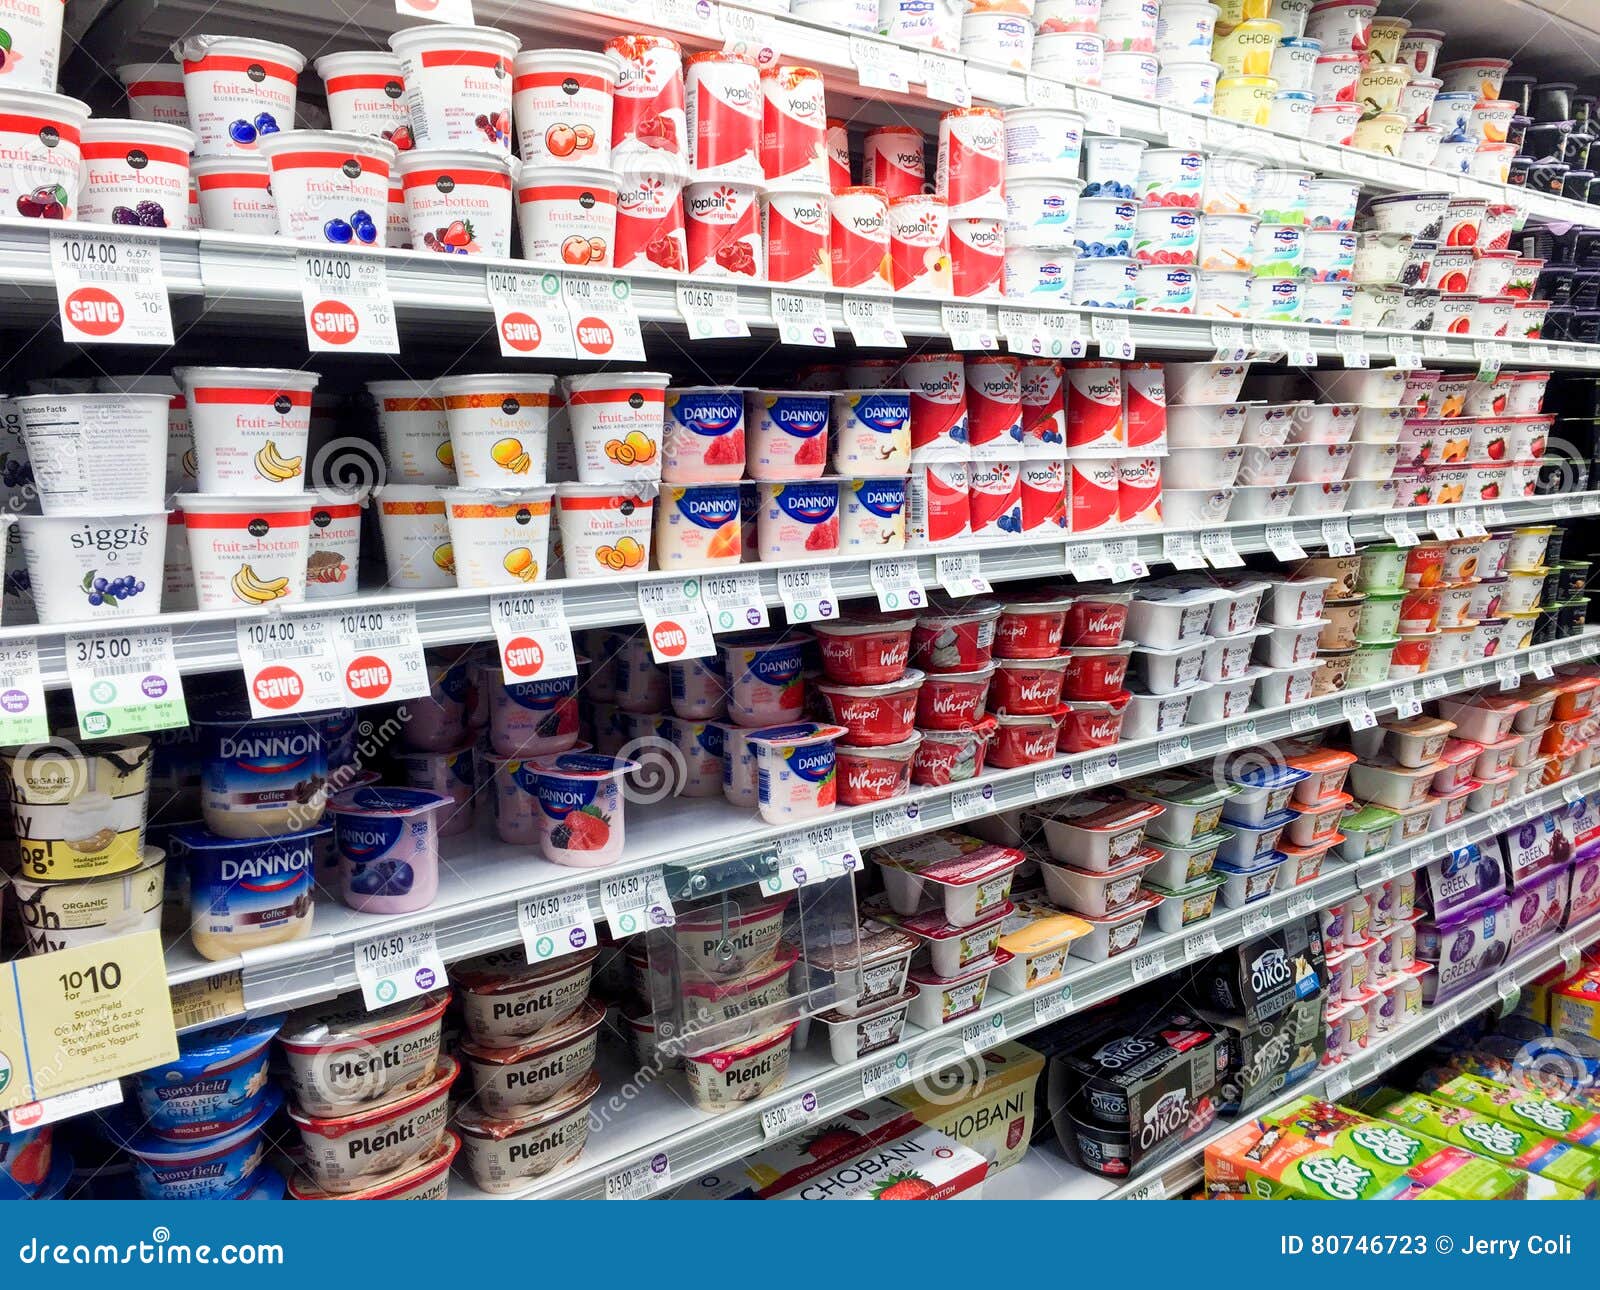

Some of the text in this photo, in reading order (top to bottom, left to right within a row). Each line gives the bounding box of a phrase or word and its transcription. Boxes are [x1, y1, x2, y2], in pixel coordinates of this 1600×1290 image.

[213, 83, 240, 95] fruit
[354, 99, 379, 112] fruit
[532, 99, 557, 110] fruit
[89, 170, 181, 189] fruit bottom
[232, 199, 260, 211] fruit
[445, 194, 489, 209] bottom
[691, 194, 726, 210] yoplait
[62, 241, 117, 265] 10/4.00
[306, 259, 351, 280] 10/4.00
[135, 292, 161, 300] SAVE
[69, 301, 120, 323] save
[366, 303, 389, 313] SAVE
[314, 312, 356, 333] save
[505, 323, 539, 342] save
[578, 327, 612, 345] save
[599, 411, 622, 422] fruit
[684, 406, 737, 420] DANNON
[780, 409, 826, 423] DANNON
[865, 406, 908, 419] DANNON
[236, 415, 264, 428] fruit
[489, 418, 532, 432] Mango
[789, 496, 834, 509] DANNON
[867, 492, 904, 504] DANNON
[690, 501, 736, 513] DANNON
[70, 523, 149, 550] siggi's
[320, 528, 356, 539] bottom
[212, 538, 299, 553] fruit bottom
[248, 622, 295, 643] 10/4.00
[340, 614, 383, 634] 10/4.00
[655, 630, 685, 649] save
[76, 638, 131, 661] 3/5.00
[399, 652, 420, 660] SAVE
[508, 648, 541, 666] save
[759, 657, 802, 673] DANNON
[350, 668, 388, 688] save
[256, 678, 300, 699] save
[516, 681, 571, 695] DANNON
[934, 696, 977, 714] Whips!
[841, 709, 879, 722] Whips!
[220, 733, 320, 758] DANNON
[799, 752, 836, 770] DANNON
[849, 772, 896, 789] Whips!
[259, 791, 285, 800] Coffee
[540, 789, 585, 804] DANNON
[221, 851, 313, 881] DANNON
[1440, 873, 1470, 897] GREEK
[62, 899, 108, 910] ORGANIC
[23, 903, 60, 929] Oh
[262, 909, 287, 919] Coffee
[59, 962, 121, 993] 10 10
[1441, 961, 1477, 983] GREEK
[65, 991, 80, 1000] for
[74, 1001, 122, 1019] Stonyfield
[493, 994, 552, 1019] Plenti
[62, 1020, 141, 1047] Stonyfield Greek
[67, 1032, 139, 1058] Organic Yogurt
[329, 1048, 400, 1082] Plenti
[726, 1060, 772, 1086] Plenti
[507, 1062, 564, 1088] Plenti
[159, 1081, 227, 1099] Stonyfield
[166, 1104, 224, 1117] GREEK
[167, 1095, 220, 1109] ORGANIC
[174, 1123, 219, 1134] WHOLE MILK
[349, 1125, 414, 1158] Plenti
[509, 1136, 564, 1161] Plenti
[156, 1164, 223, 1181] Stonyfield
[801, 1139, 925, 1200] CHOBANI
[164, 1179, 216, 1192] ORGANIC
